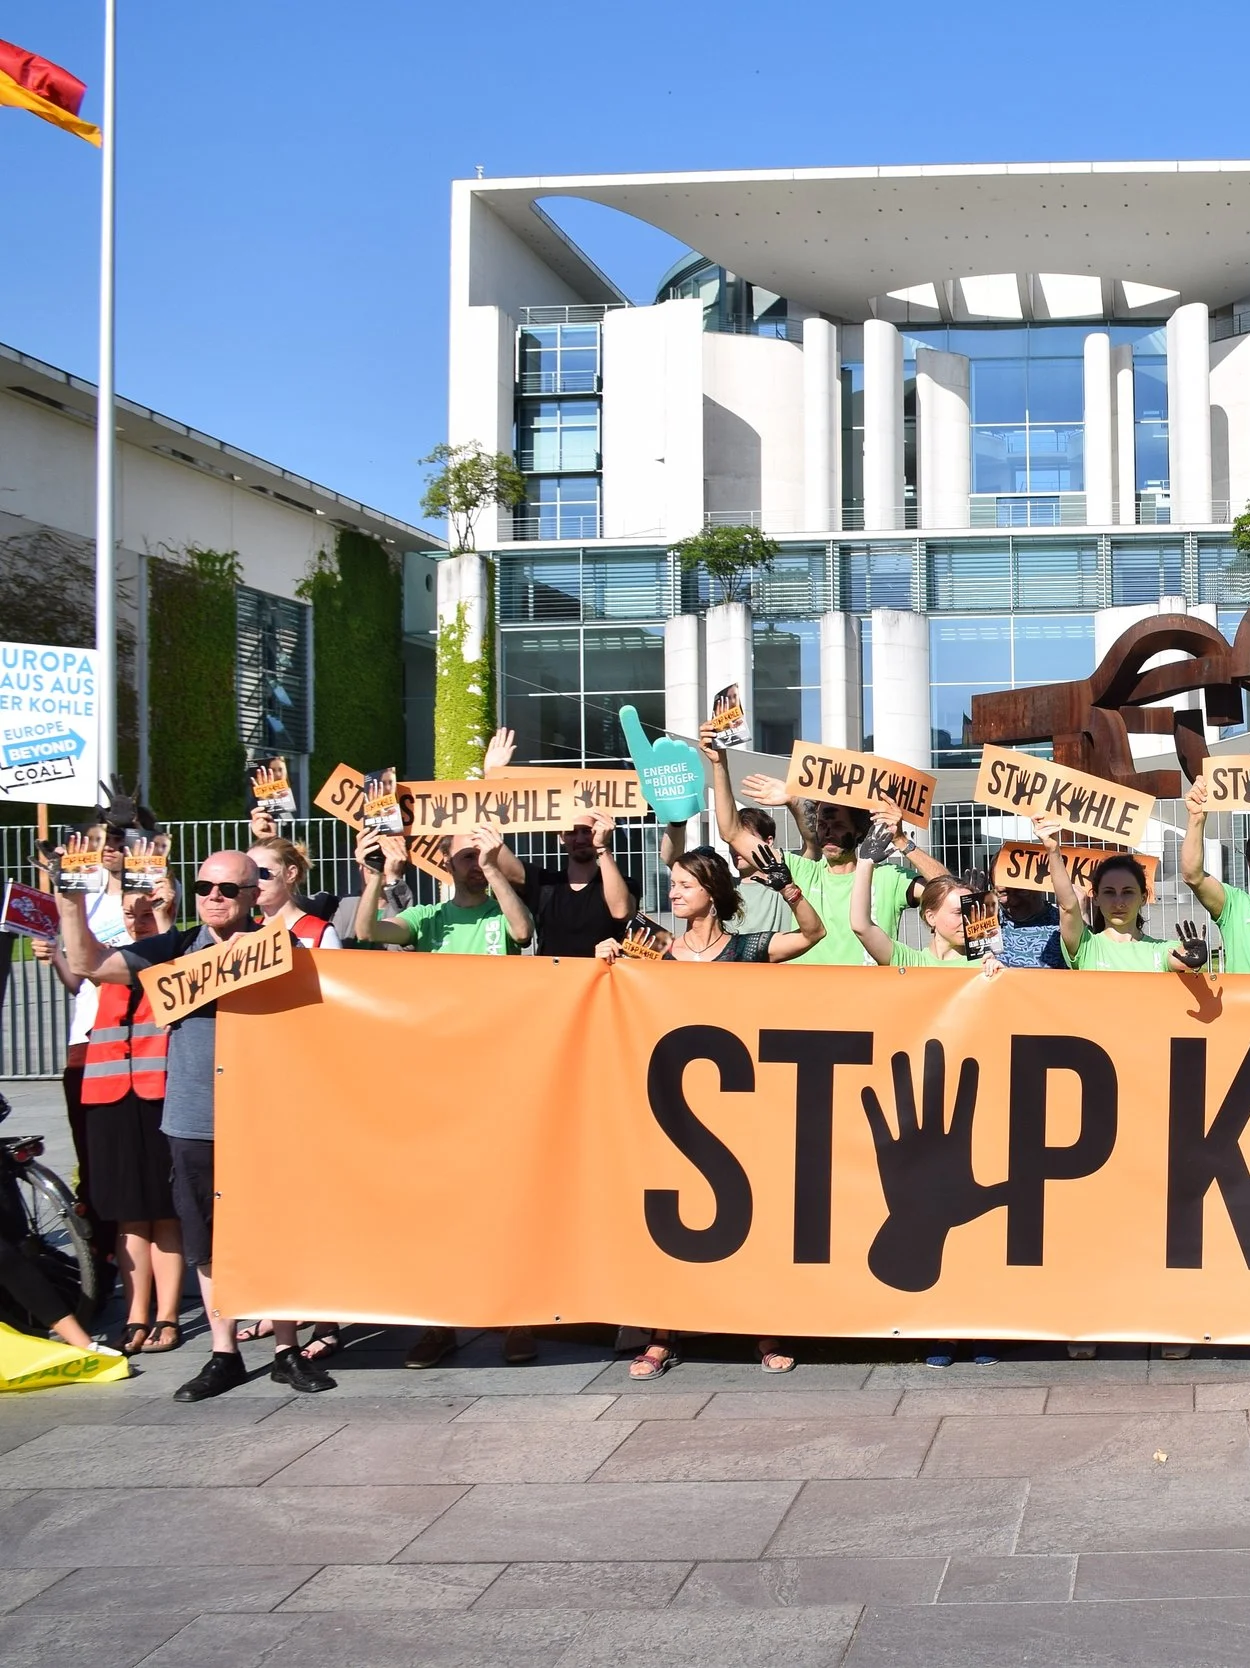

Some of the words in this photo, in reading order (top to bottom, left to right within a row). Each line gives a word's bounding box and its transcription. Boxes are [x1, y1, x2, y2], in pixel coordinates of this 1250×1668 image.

[2, 647, 94, 675] UROPA
[0, 672, 44, 692] AUS
[50, 677, 94, 696] AUS
[0, 695, 23, 711] ER
[29, 697, 94, 716] KOHLE
[4, 721, 64, 741] EUROPE
[9, 739, 78, 761] BEYOND
[14, 765, 62, 781] COAL
[643, 762, 688, 777] ENERGIE
[653, 772, 699, 787] BÜRGER-
[654, 785, 685, 797] HAND
